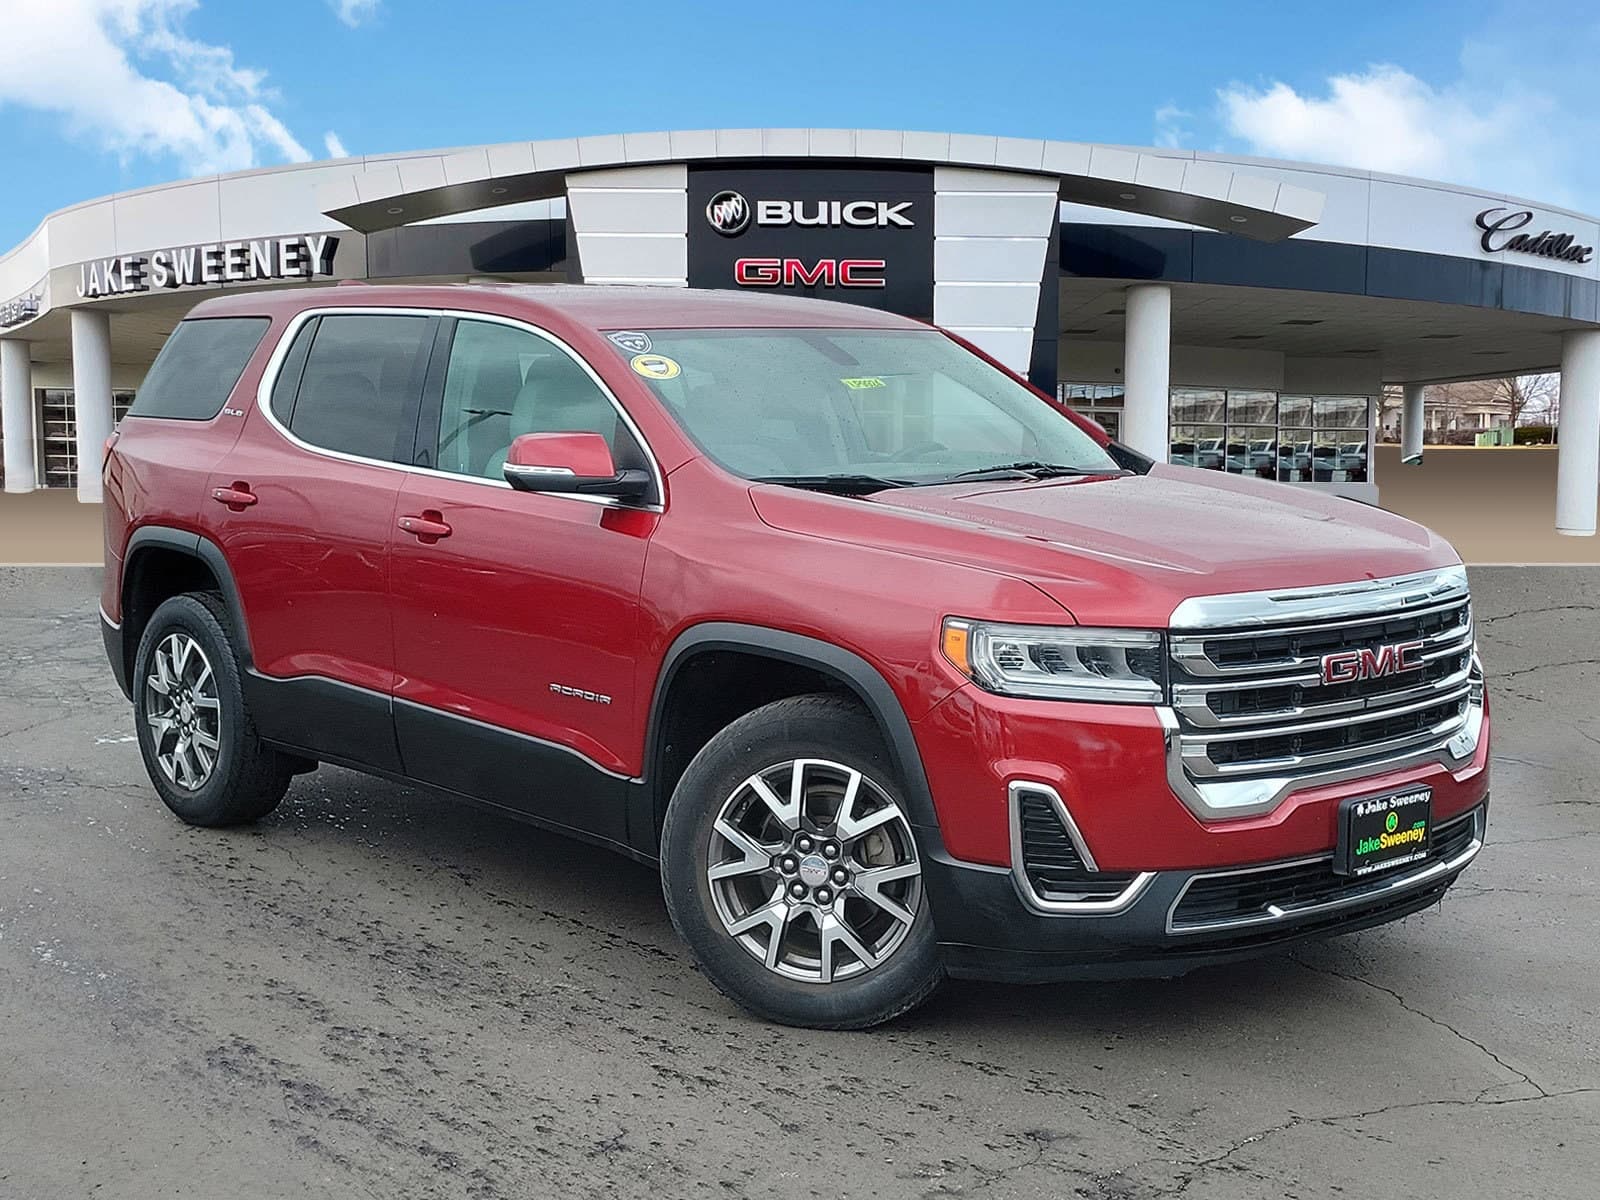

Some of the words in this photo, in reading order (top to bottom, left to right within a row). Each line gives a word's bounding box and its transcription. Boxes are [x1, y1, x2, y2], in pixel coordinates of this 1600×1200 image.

[757, 200, 915, 226] BUICK
[1475, 207, 1593, 263] Cadillac
[76, 256, 146, 298] JAKE
[151, 234, 337, 288] SWEENEY
[735, 258, 886, 287] GMC
[1321, 640, 1425, 686] GMC
[1365, 801, 1388, 815] Jake
[1389, 791, 1431, 808] Sweeney
